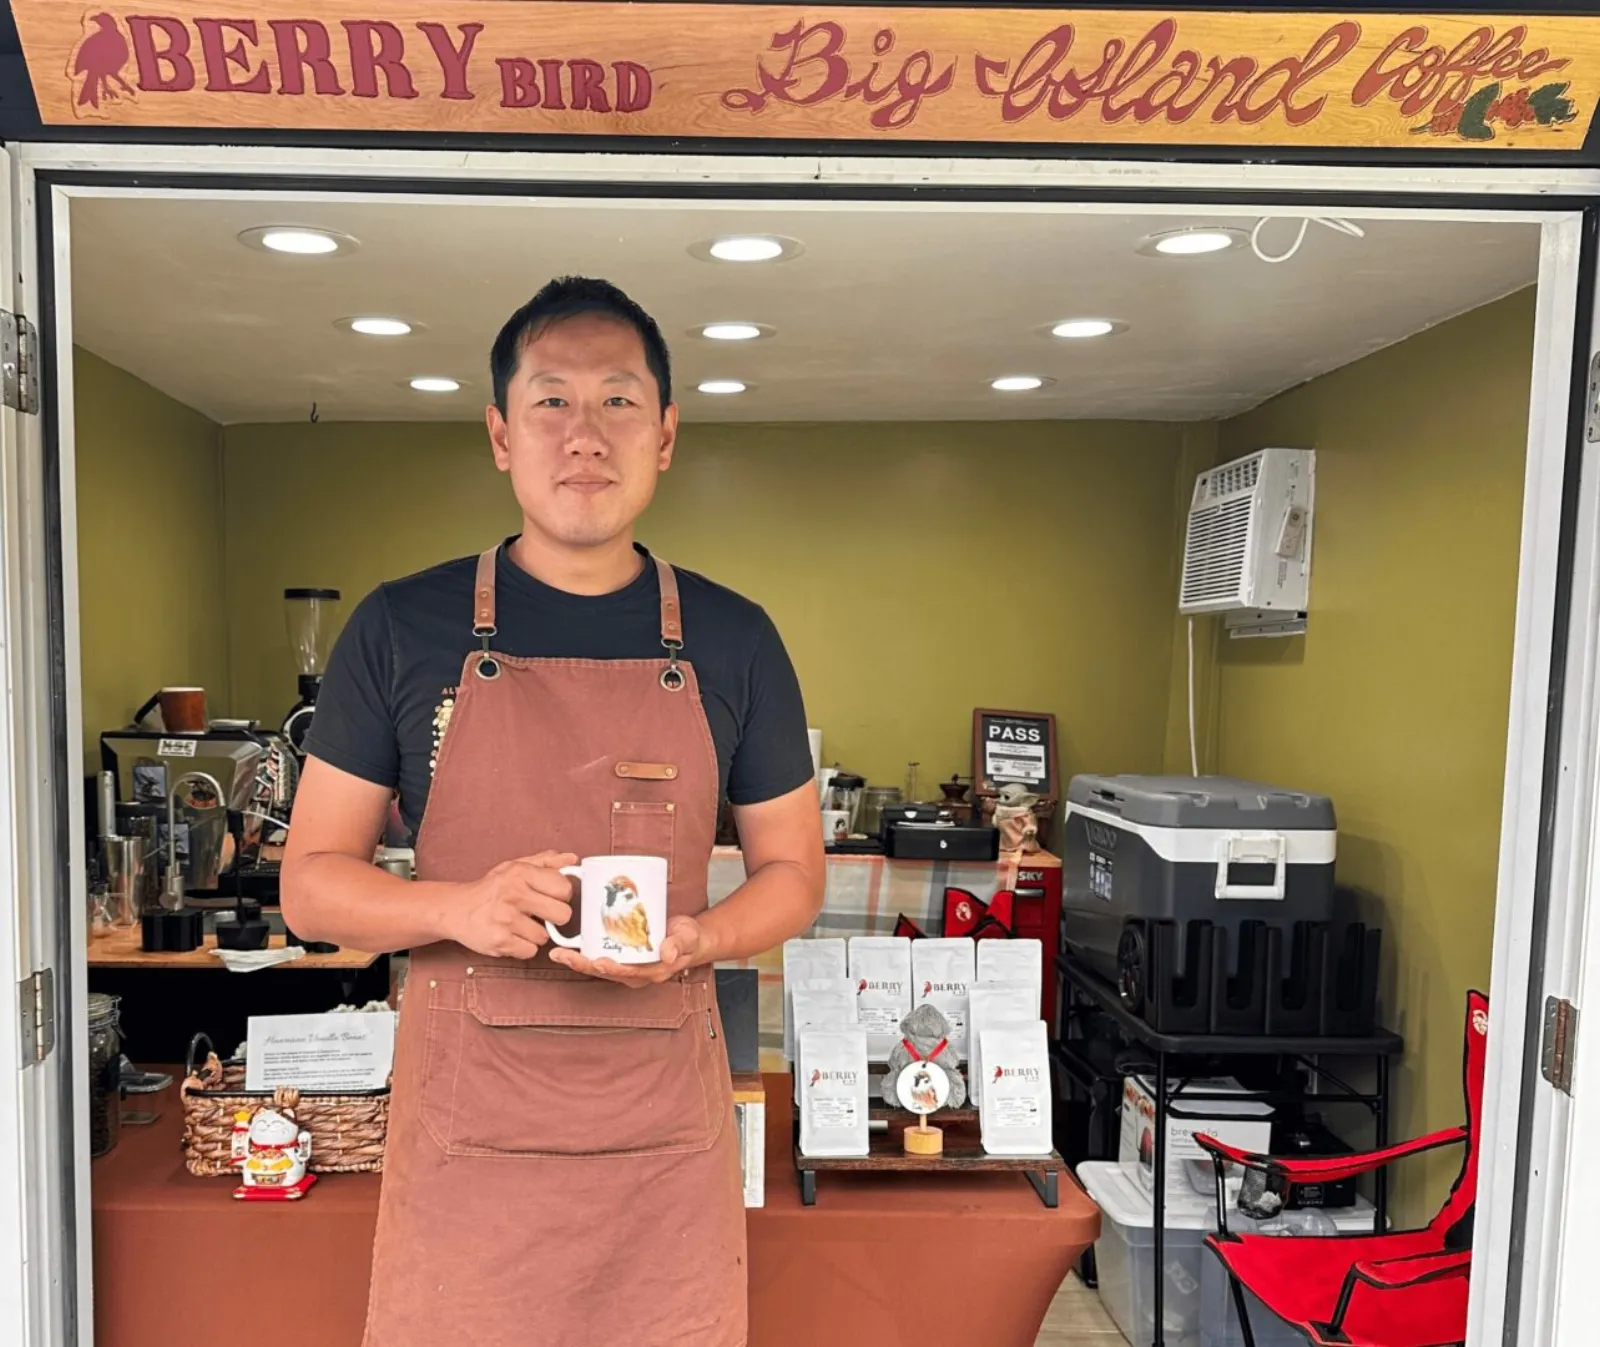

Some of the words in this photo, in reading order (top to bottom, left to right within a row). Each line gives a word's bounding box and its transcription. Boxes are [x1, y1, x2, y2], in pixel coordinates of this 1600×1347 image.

[125, 15, 484, 99] BERRY
[495, 57, 652, 112] BIRD
[720, 17, 956, 129] Big
[973, 17, 1362, 126] Island
[1351, 24, 1574, 118] Coffee
[988, 725, 1041, 743] PASS
[933, 983, 968, 992] BERRY
